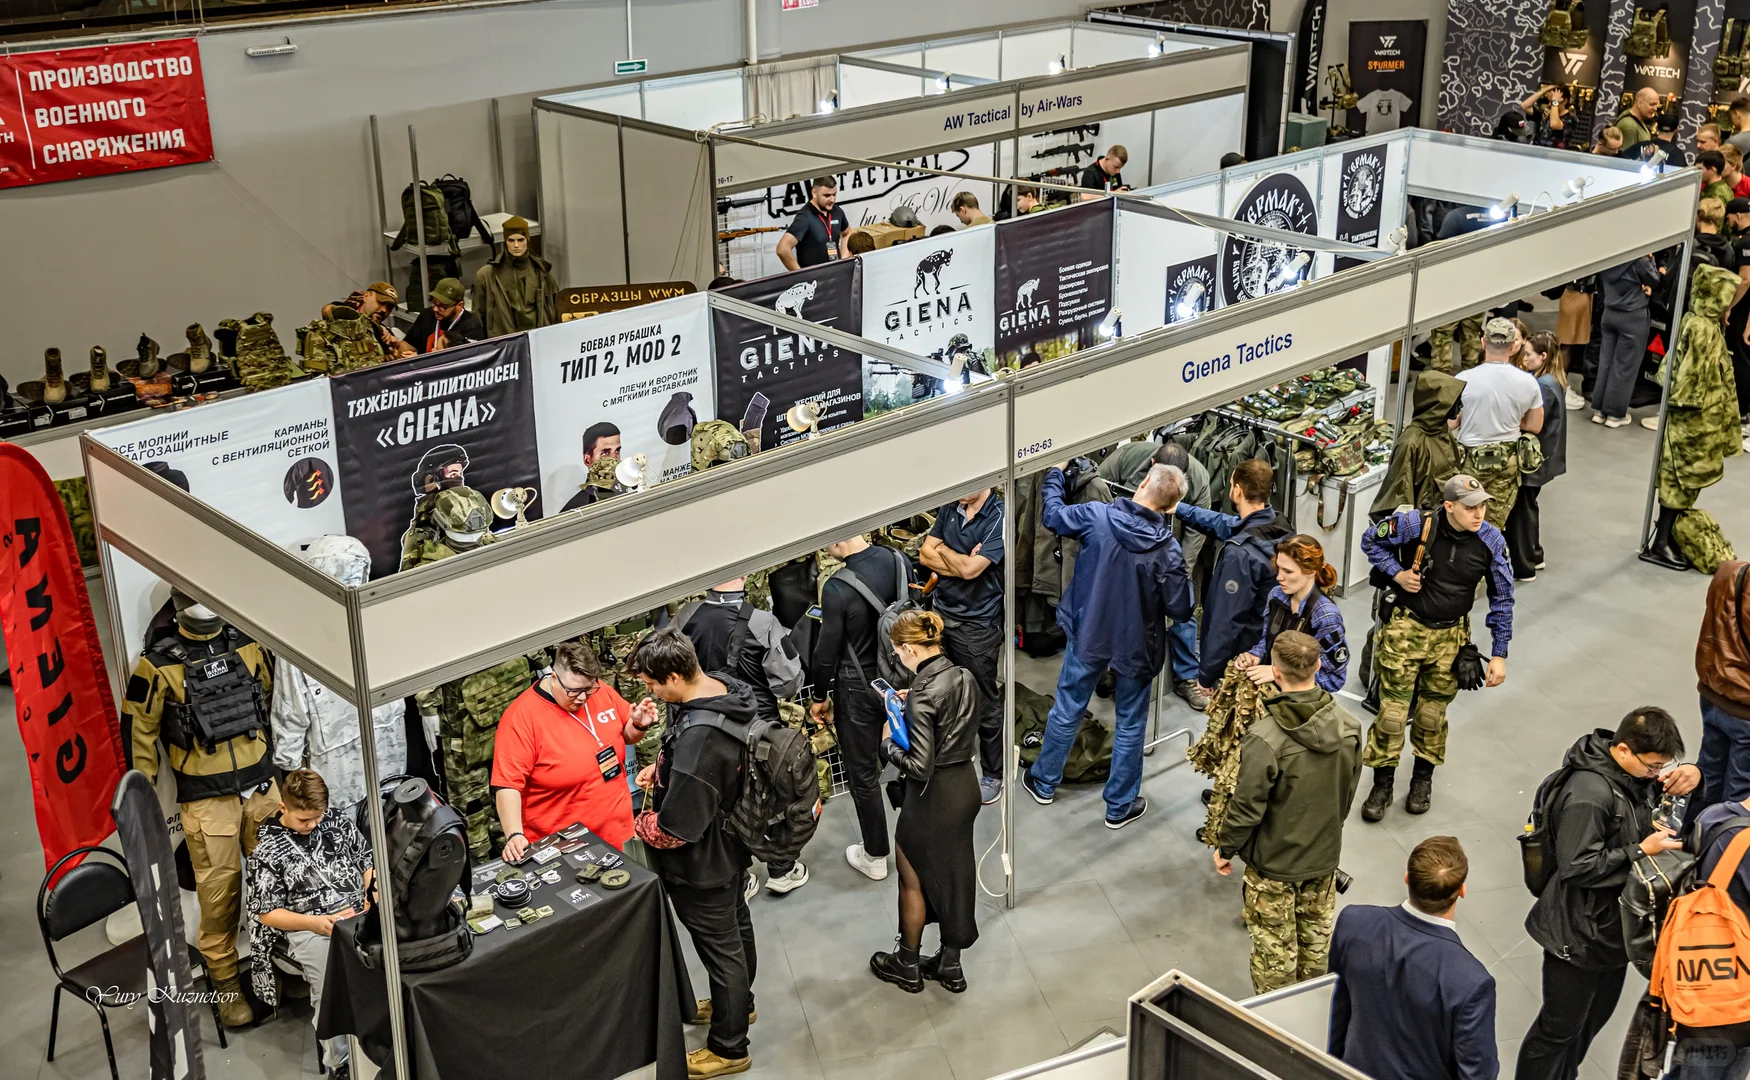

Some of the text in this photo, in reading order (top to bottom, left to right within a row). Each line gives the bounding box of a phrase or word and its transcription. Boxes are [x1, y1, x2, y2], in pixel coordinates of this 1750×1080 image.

[1305, 5, 1322, 91] WARTECH
[28, 56, 193, 91] ПРОИЗВОДСТВО
[1367, 60, 1405, 71] STURMER
[1633, 63, 1681, 79] WARTECH
[34, 97, 147, 128] ВОЕННОГО
[943, 94, 1083, 132] AW Tactical by Air-Wars
[42, 128, 186, 164] СНАРЯЖЕНИЯ
[717, 175, 735, 185] 16-17
[569, 290, 642, 304] ОБРАЗЦЫ
[884, 292, 973, 332] GIENA
[885, 313, 974, 345] TACTICS
[999, 304, 1050, 331] GIENA
[999, 319, 1051, 338] TACTICS
[580, 323, 662, 354] БОЕВАЯ РУБАШКА
[740, 328, 836, 370] GIEN
[560, 333, 682, 385] ТИП 2, MOD 2
[740, 349, 840, 383] TACTICS
[1181, 332, 1293, 383] Giena Tactics
[346, 360, 520, 419] ТЯЖЁЛЫЙ ПЛИТОНОСЕЦ
[602, 375, 699, 408] С МЯГКИМИ ВСТАВКАМИ
[619, 367, 698, 395] ПЛЕЧИ И ВОРОТНИК
[827, 388, 841, 399] ДЛЯ
[273, 418, 328, 439] КАРМАНЫ
[375, 395, 497, 448] «GIENA»
[125, 430, 229, 461] АГОЗАЩИТНЫЕ
[138, 429, 189, 450] МОЛНИИ
[211, 427, 330, 466] С ВЕНТИЛЯЦИОННОЙ
[287, 438, 331, 459] СЕТКОЙ
[1017, 438, 1053, 459] 61-62-63
[662, 462, 691, 478] МАНЖЕ
[597, 708, 617, 724] GT
[1676, 955, 1750, 982] NASA
